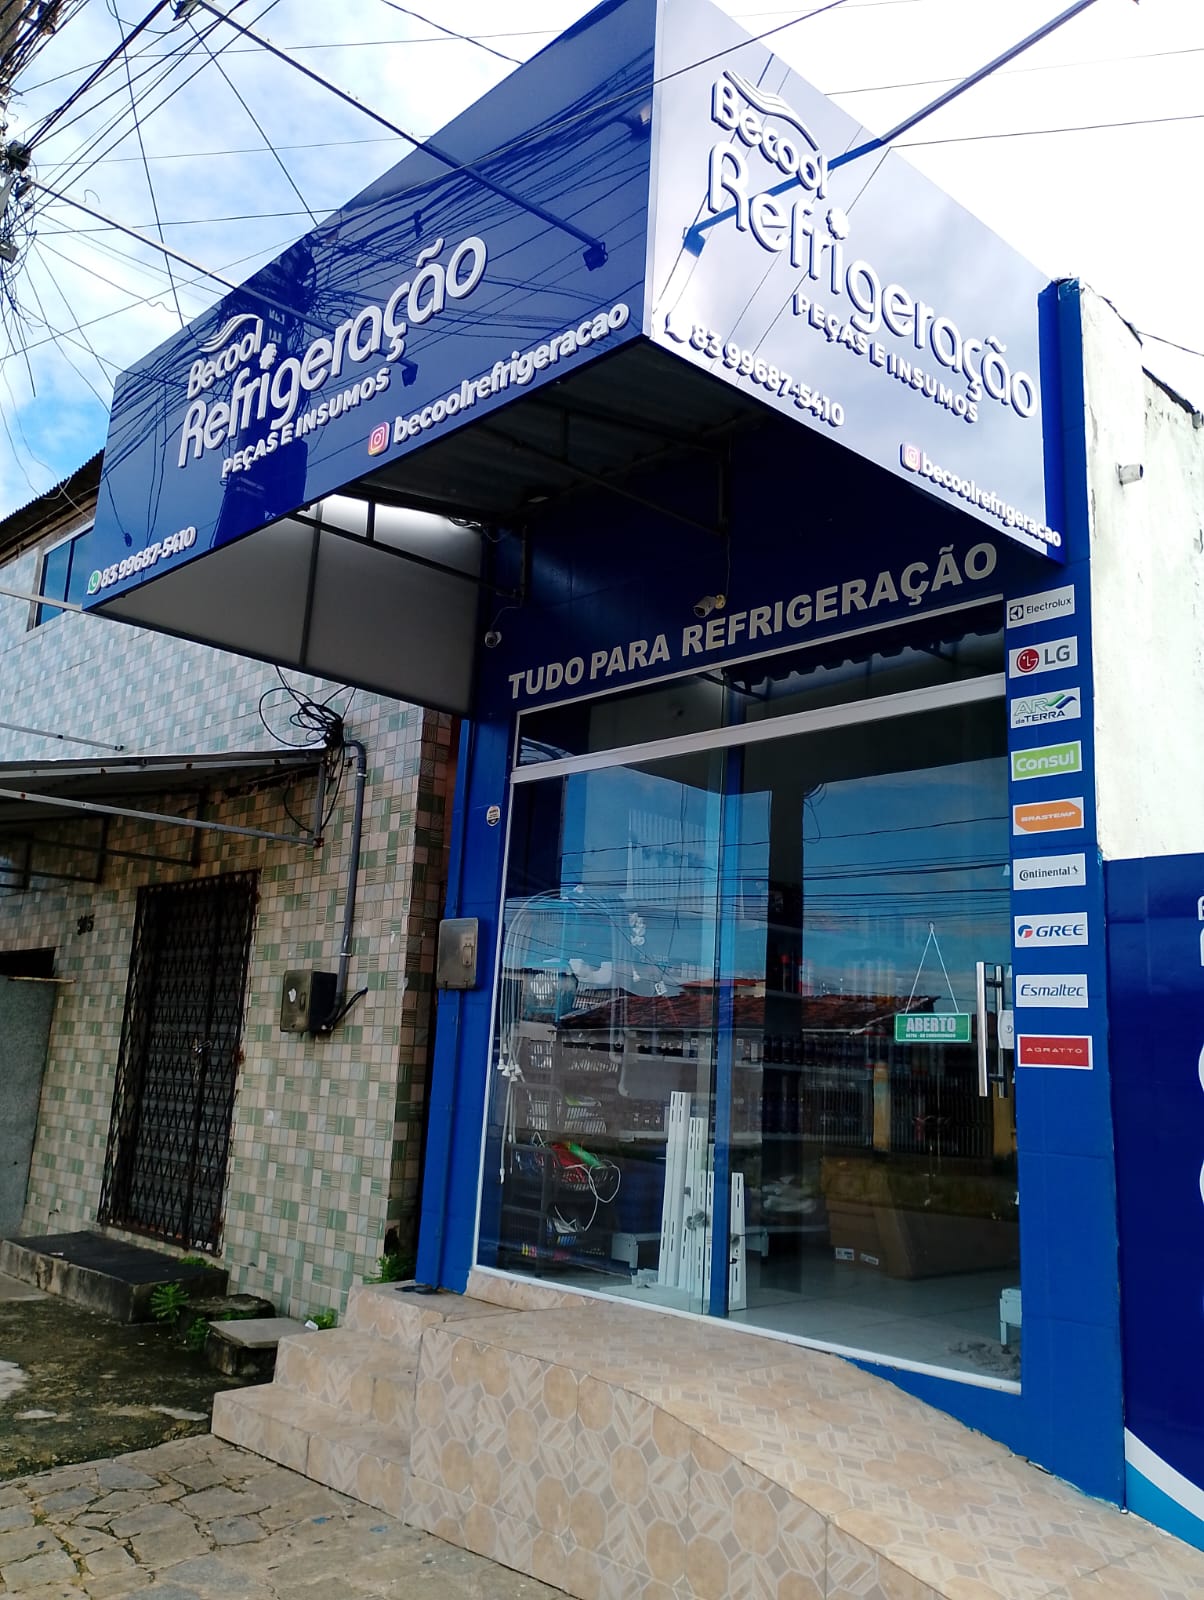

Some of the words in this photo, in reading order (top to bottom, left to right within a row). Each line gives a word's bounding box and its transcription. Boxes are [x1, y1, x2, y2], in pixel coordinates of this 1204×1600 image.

[711, 78, 828, 199] Becool
[708, 140, 1038, 418] Refrigeração
[178, 236, 487, 467] Refrigeração
[187, 319, 263, 399] Becool
[393, 303, 629, 443] becoolrefrigeracao
[689, 324, 722, 359] 83
[722, 342, 845, 428] 99687-5410
[793, 292, 868, 356] PEÇAS
[870, 341, 886, 368] E
[887, 352, 979, 424] INSUMOS
[221, 432, 278, 479] PEÇAS
[280, 422, 294, 446] E
[295, 367, 390, 438] INSUMOS
[918, 452, 1062, 548] becoolrefrigeracao
[101, 563, 119, 588] 83
[118, 526, 197, 580] 99687-5410
[508, 656, 585, 699] TUDO
[590, 633, 671, 680] PARA
[681, 542, 998, 657] REFRIGERAÇÃO
[1026, 597, 1072, 614] Electrolux
[1044, 645, 1070, 665] LG
[1014, 697, 1049, 717] AR
[1016, 750, 1074, 773] Consul
[1021, 810, 1076, 822] BRASTEMP
[1019, 866, 1070, 881] Continental
[1036, 923, 1084, 938] GREE
[906, 1017, 957, 1033] ABERTO
[1020, 984, 1084, 997] Esmaltec
